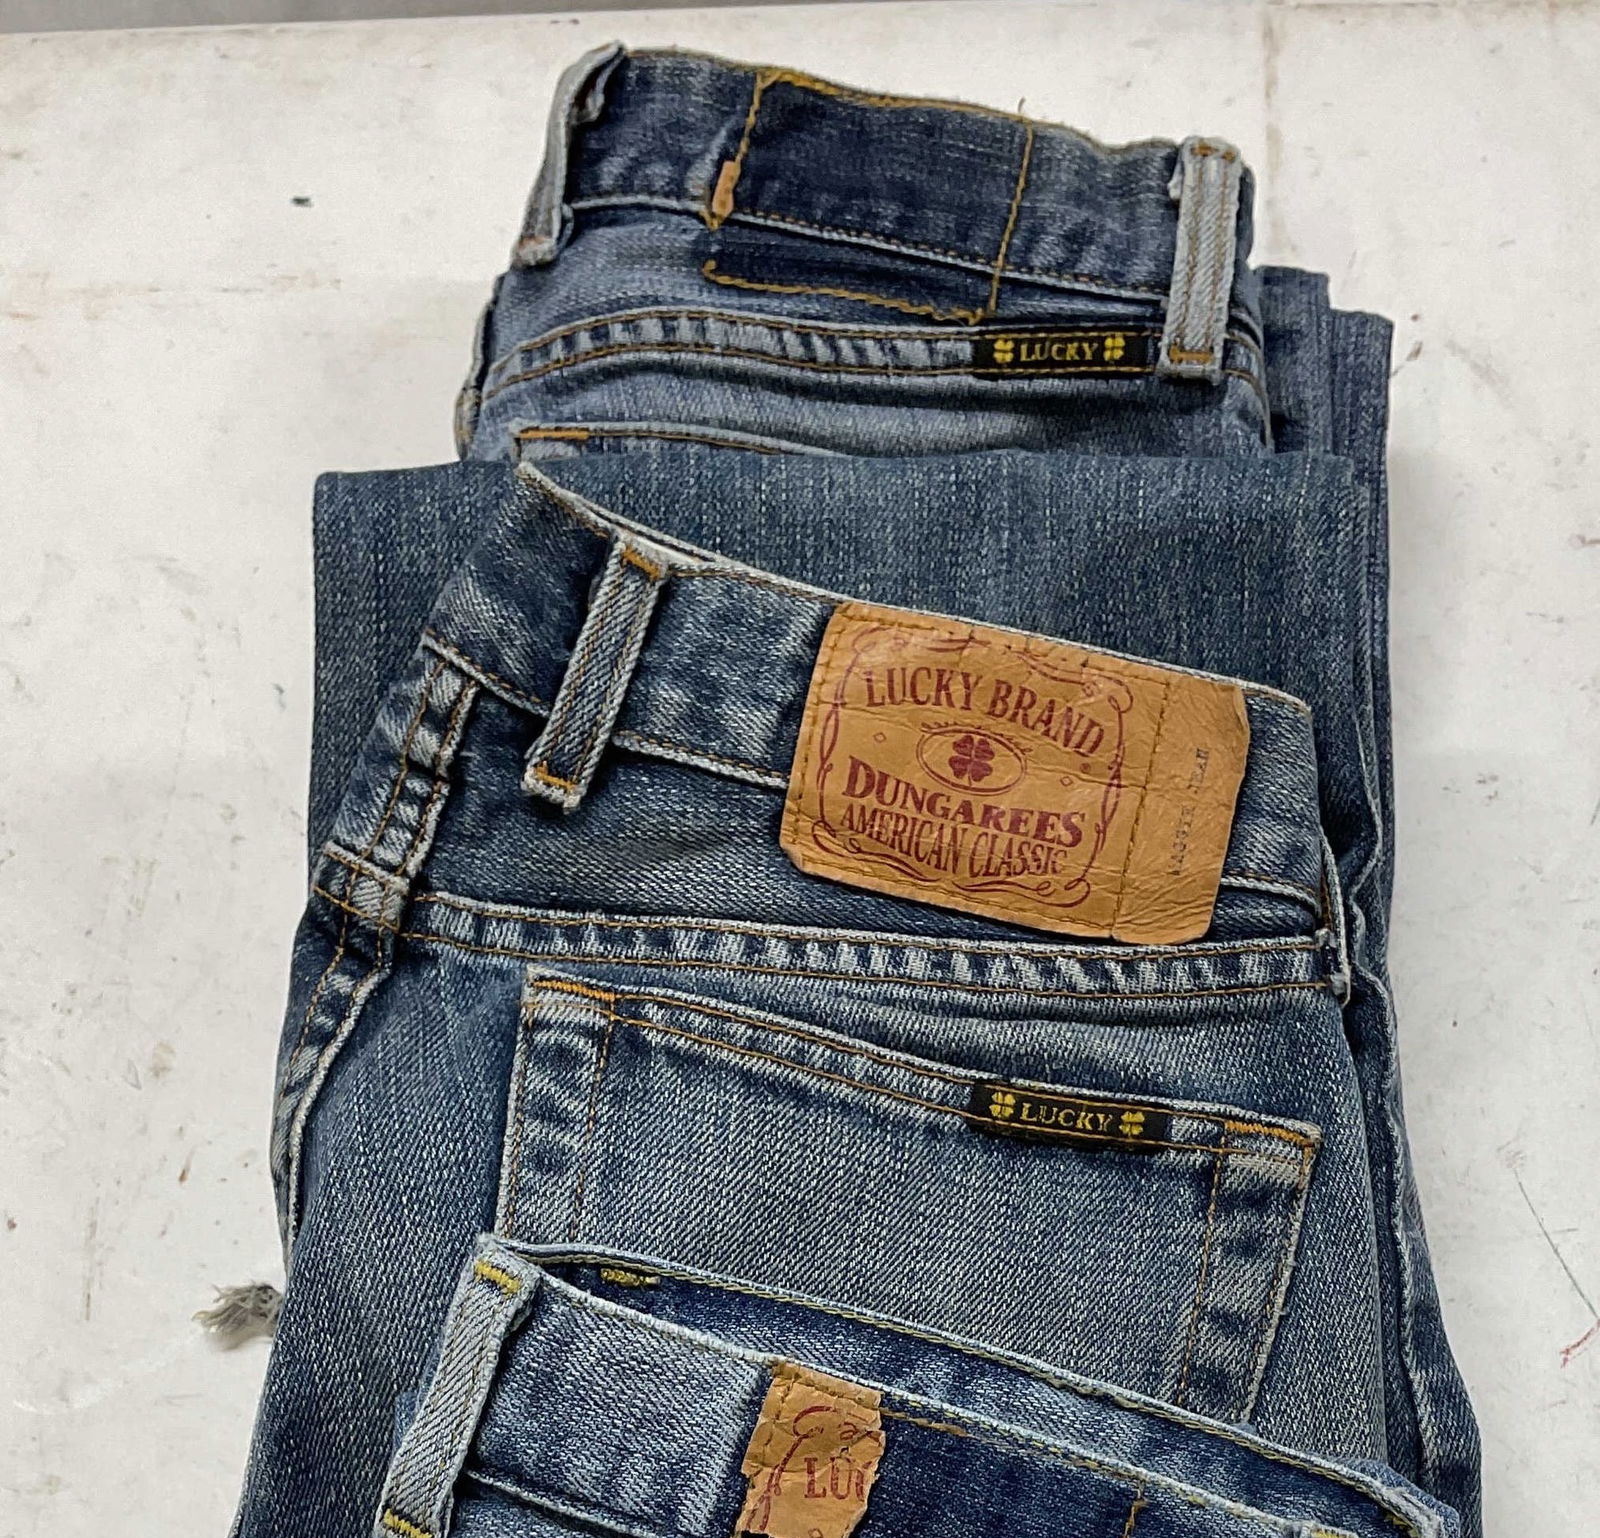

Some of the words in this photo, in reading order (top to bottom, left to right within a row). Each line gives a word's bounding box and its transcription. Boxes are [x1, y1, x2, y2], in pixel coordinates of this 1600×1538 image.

[1019, 341, 1099, 362] LUCKY
[863, 665, 984, 715] LUCKY
[986, 679, 1106, 758] BRAND
[842, 756, 1086, 849] DUNGAREES
[840, 803, 968, 874] AMERICAN
[969, 831, 1068, 878] CLASSIC
[1019, 1102, 1113, 1132] LUCKY
